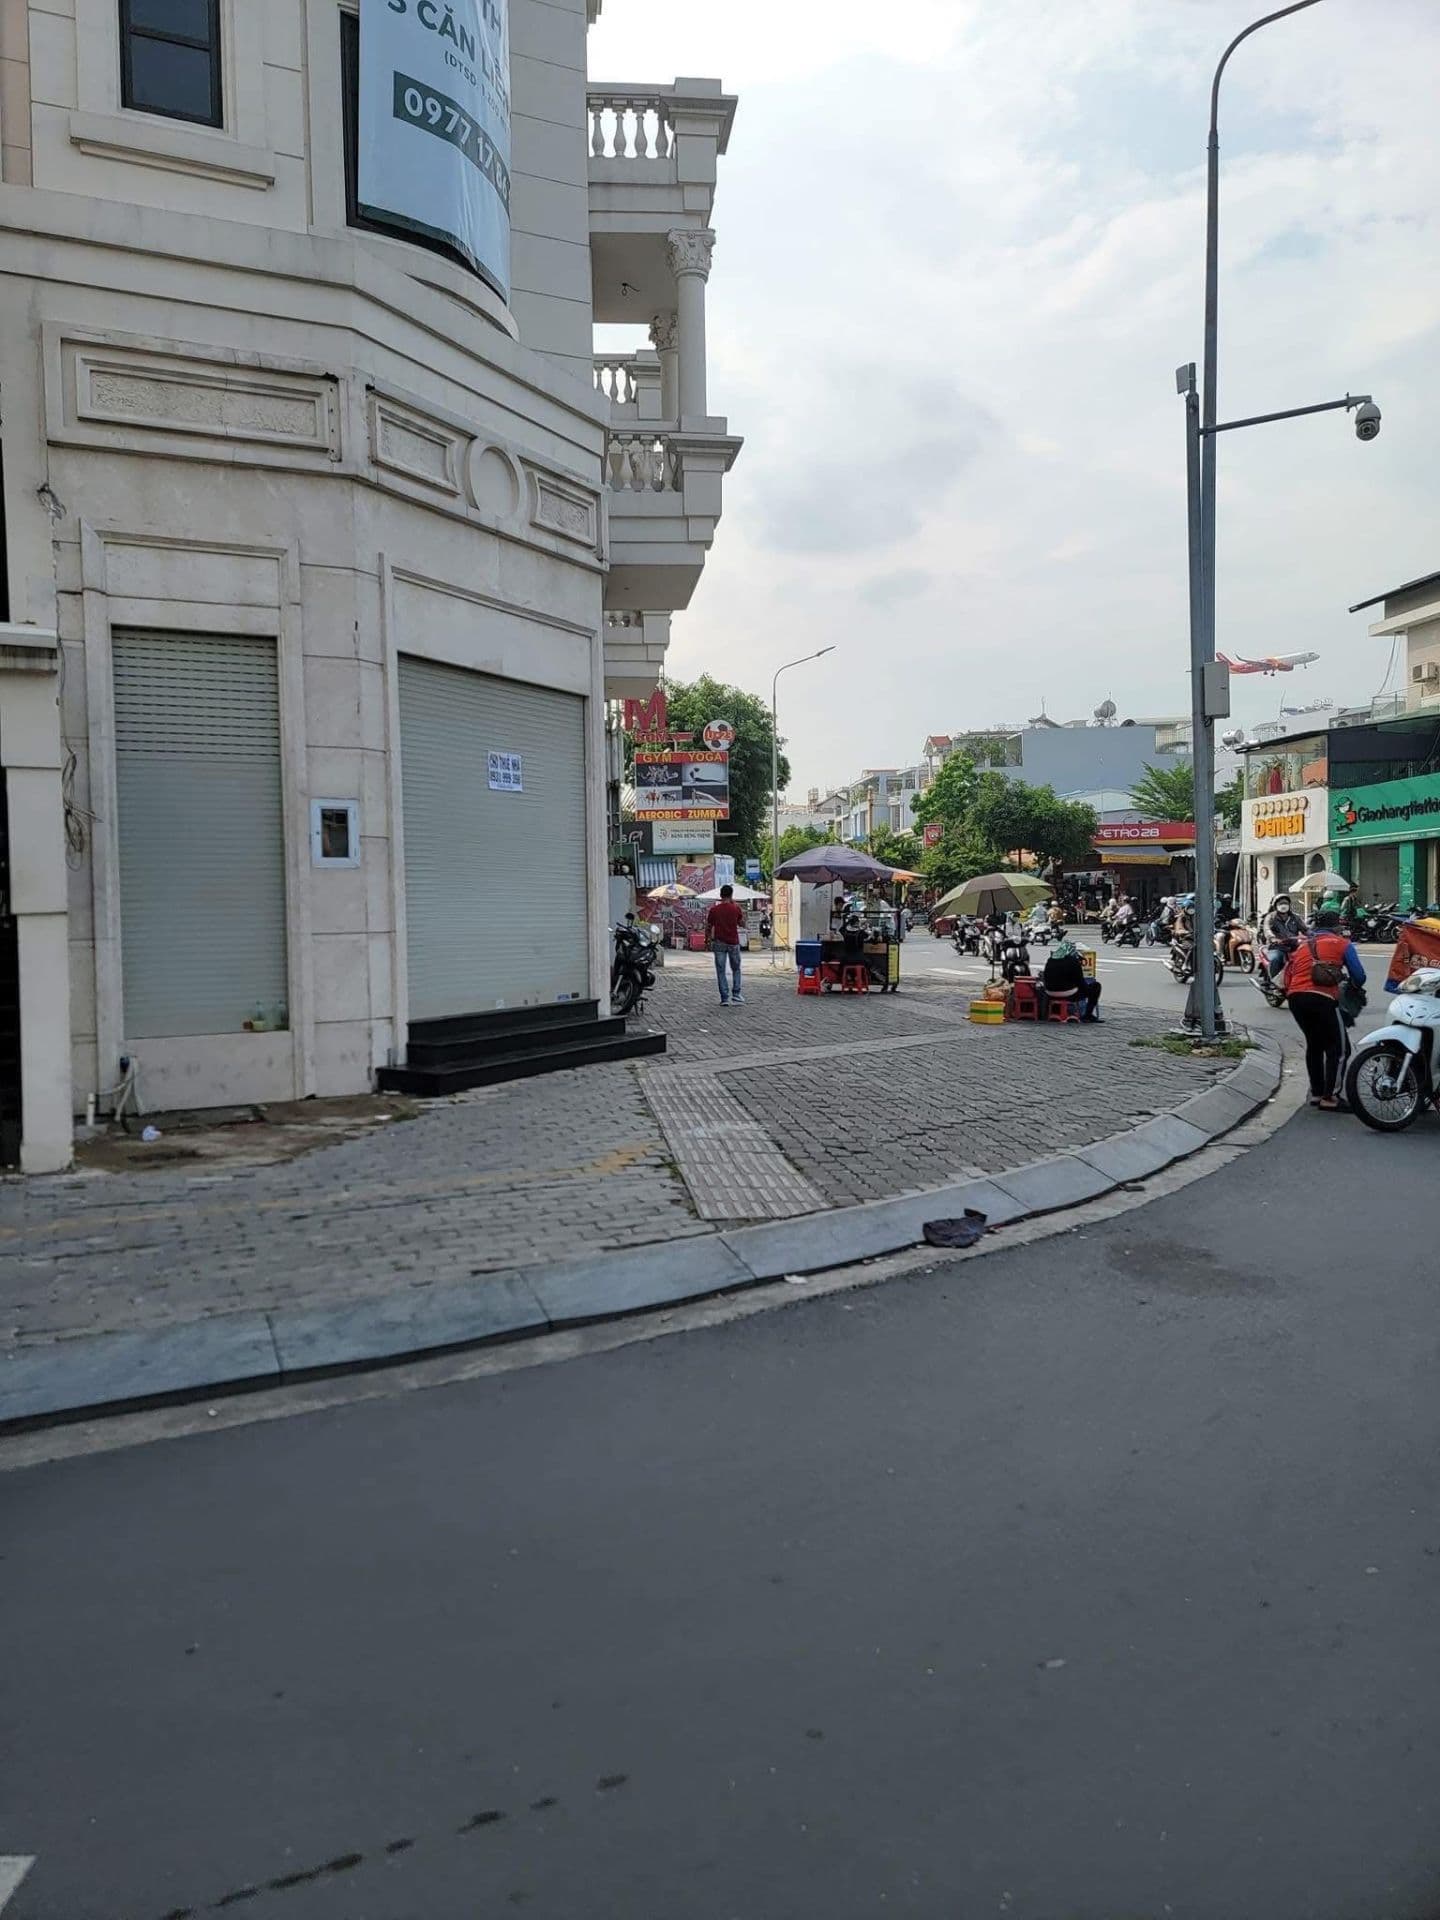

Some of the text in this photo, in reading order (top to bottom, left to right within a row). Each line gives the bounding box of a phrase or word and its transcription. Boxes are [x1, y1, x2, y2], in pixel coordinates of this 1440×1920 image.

[417, 0, 475, 62] CĂN
[404, 87, 472, 145] 0977
[477, 137, 494, 169] 17
[642, 753, 722, 763] GYM YOGA
[638, 809, 724, 820] AEROBIC ZUMBA
